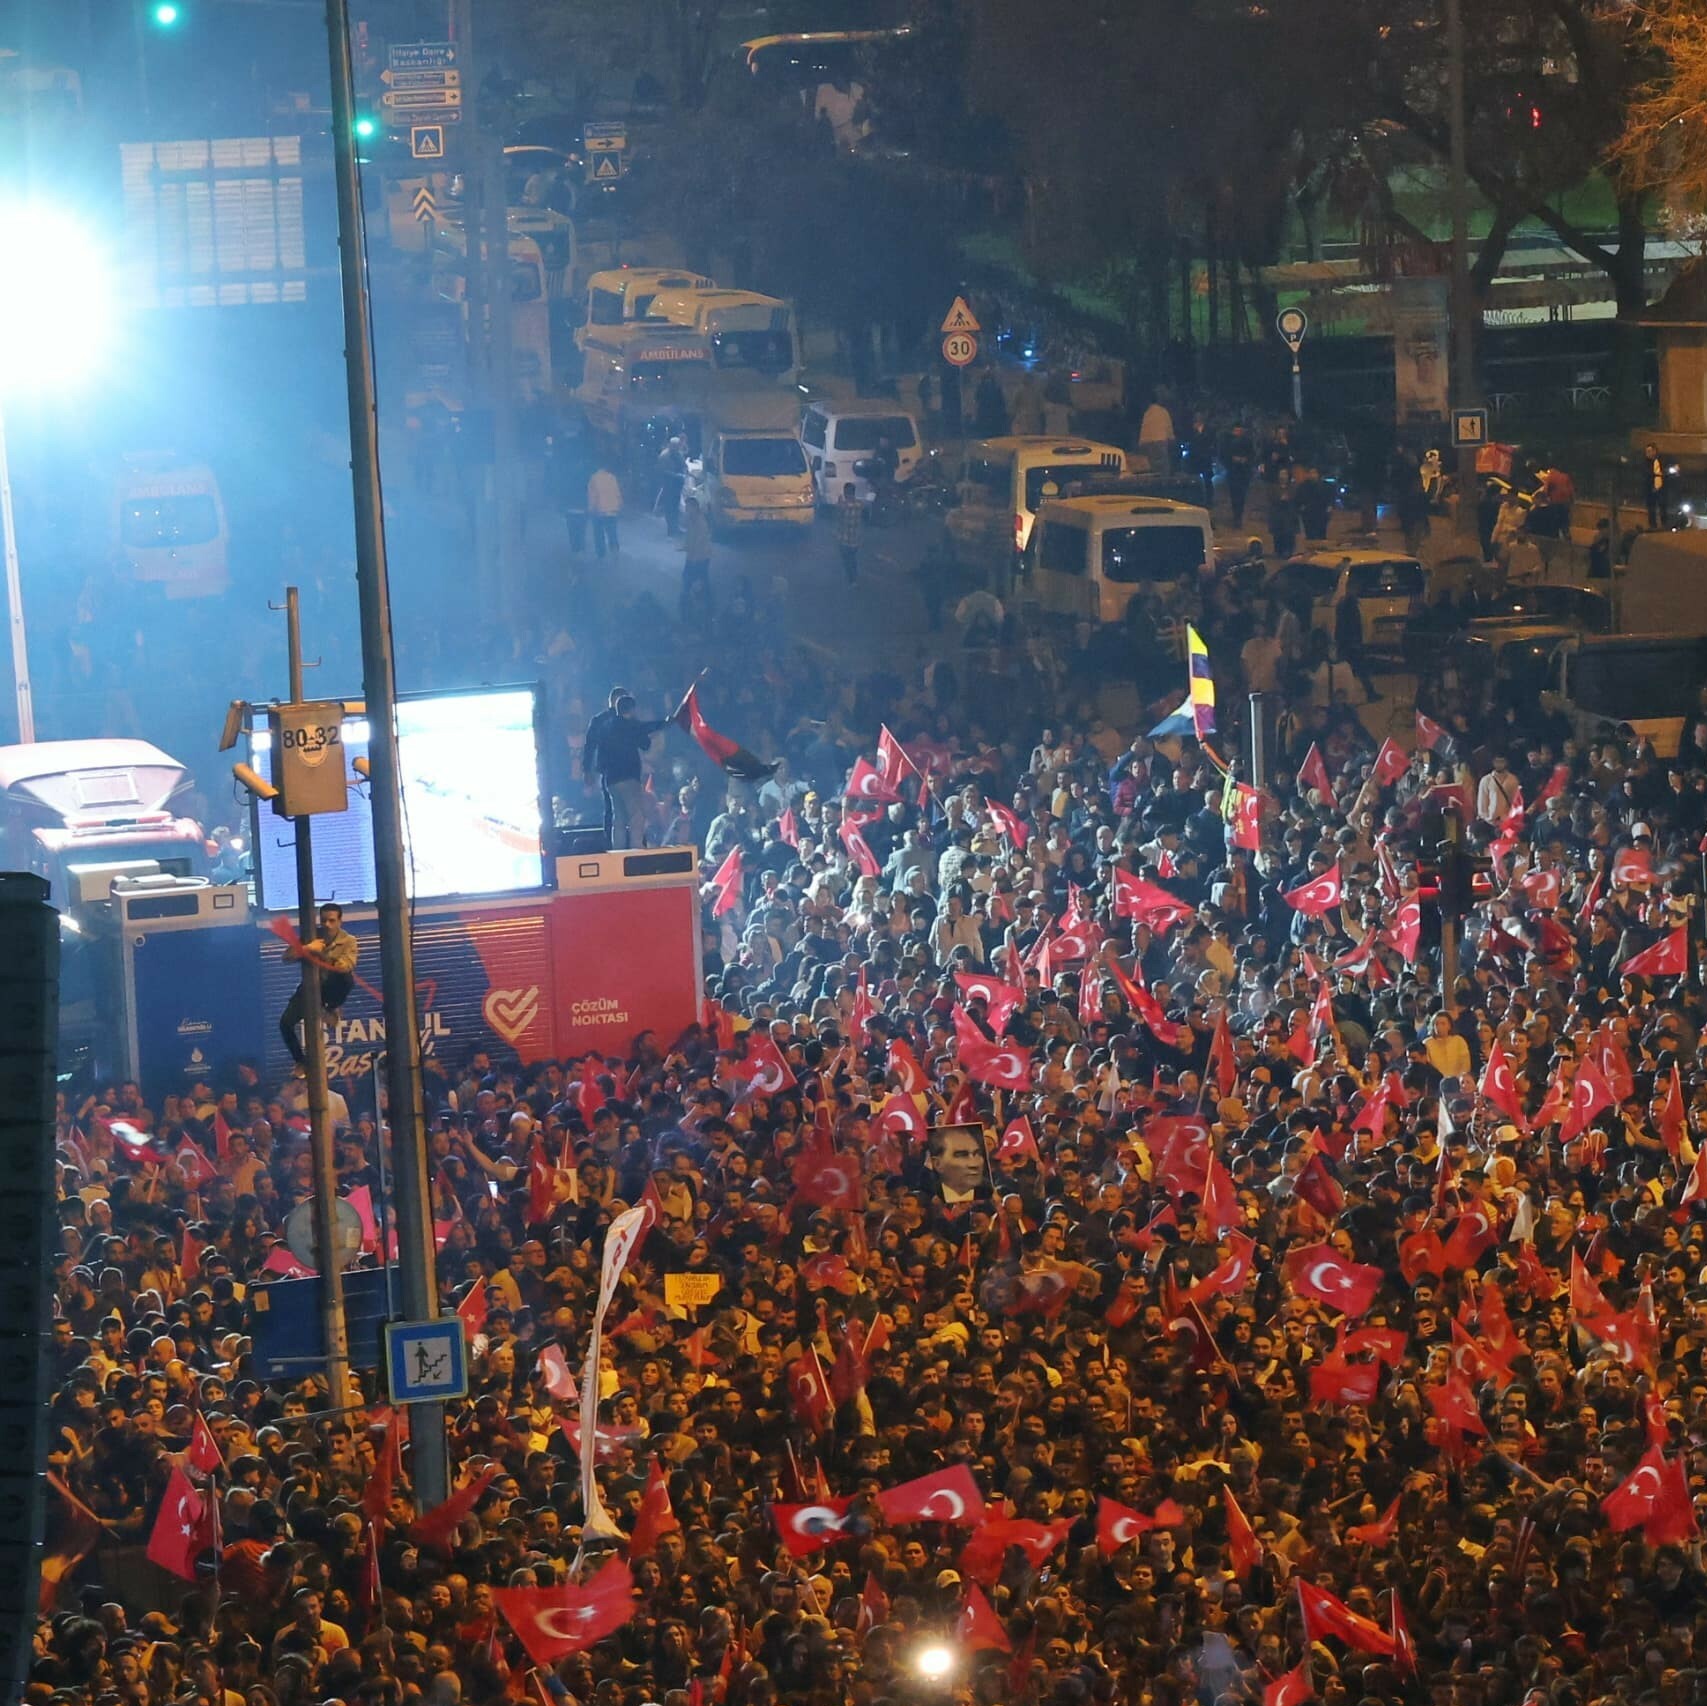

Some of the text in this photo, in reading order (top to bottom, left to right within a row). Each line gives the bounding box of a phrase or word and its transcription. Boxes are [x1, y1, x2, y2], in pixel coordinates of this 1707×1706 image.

[640, 349, 704, 361] AMBULANS
[950, 341, 969, 355] 30
[571, 997, 618, 1015] ÇÖZÜM
[571, 1012, 629, 1027] NOKTASI
